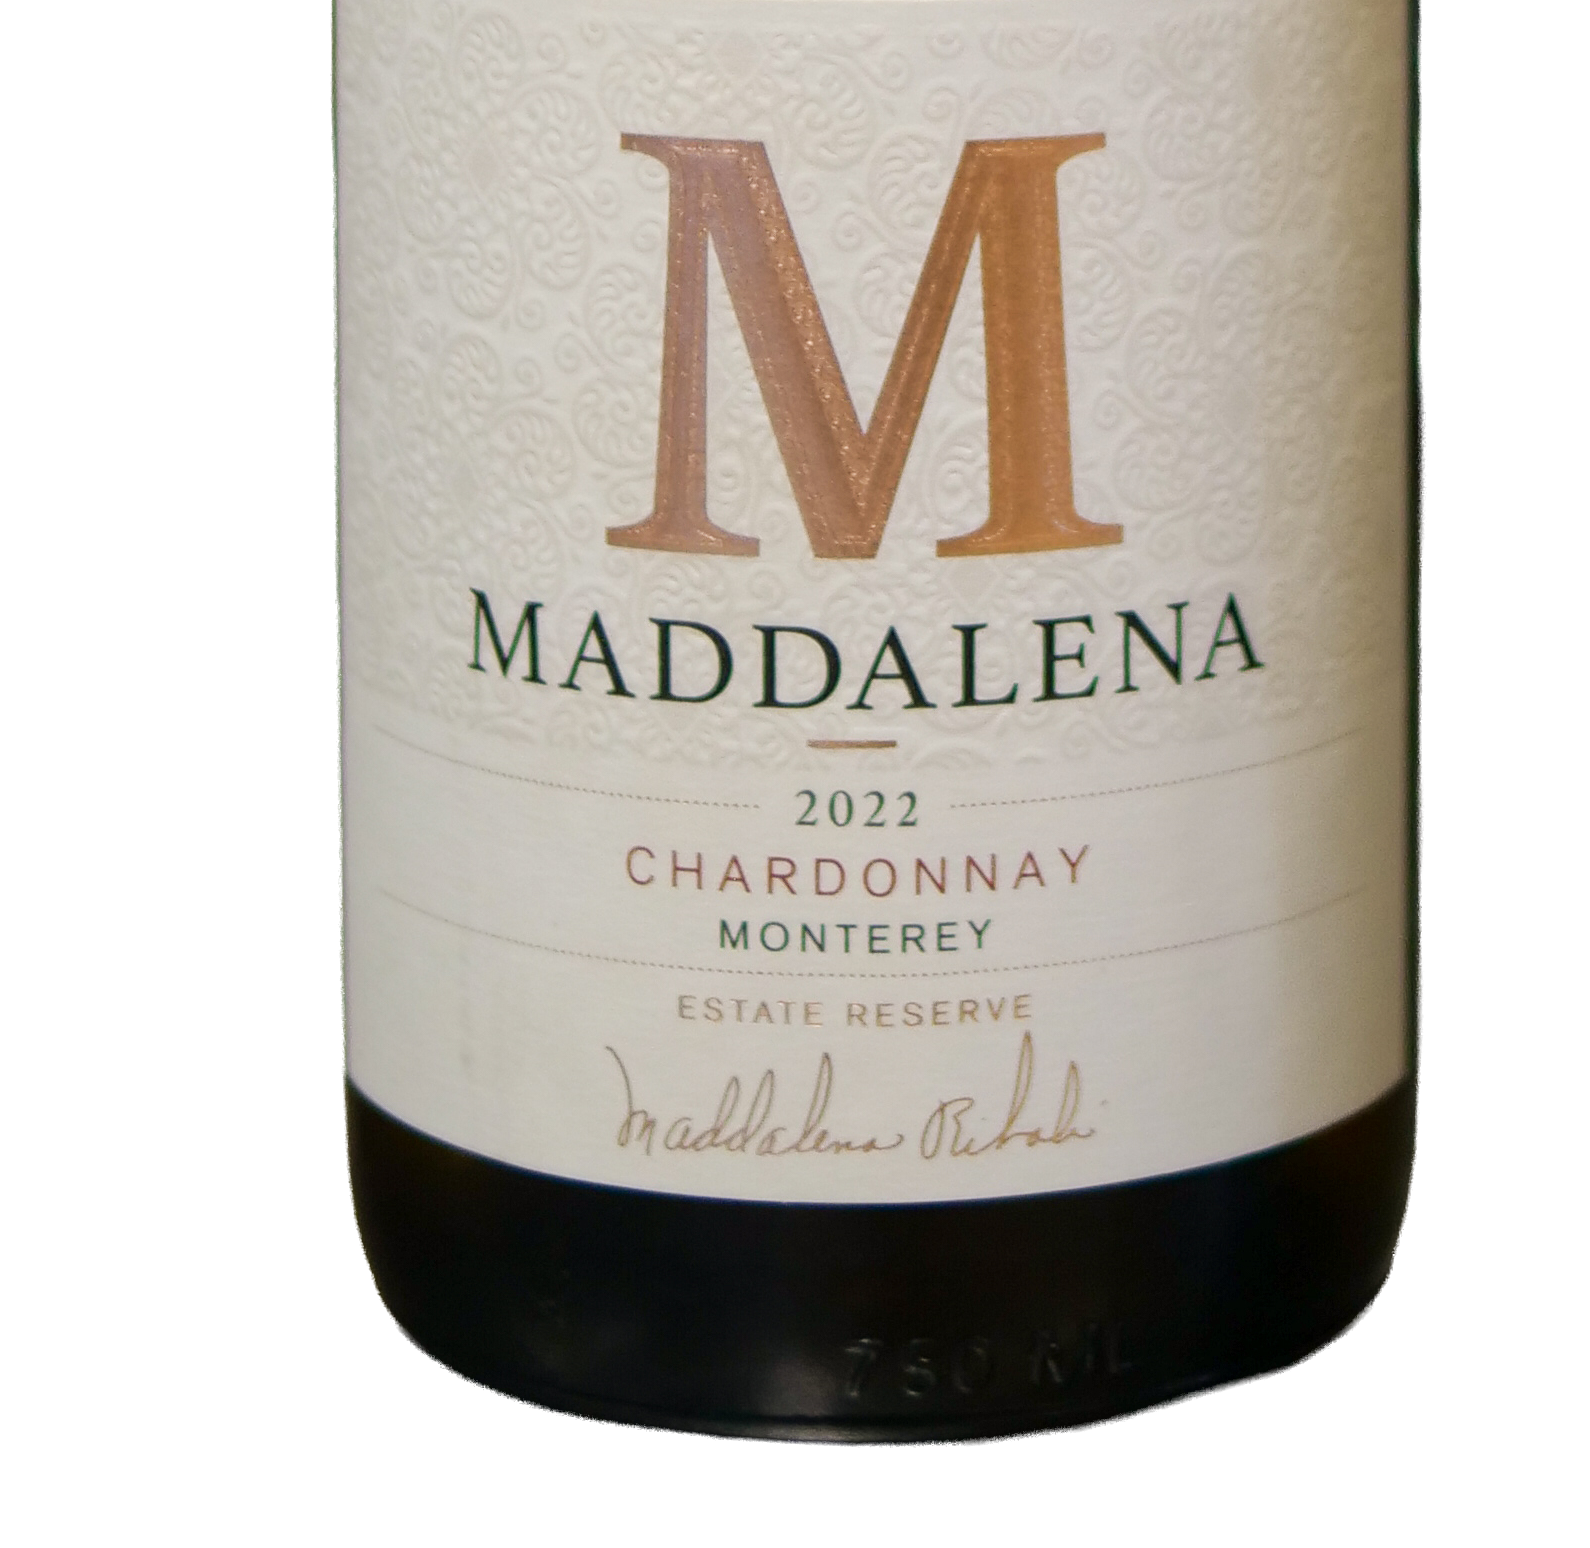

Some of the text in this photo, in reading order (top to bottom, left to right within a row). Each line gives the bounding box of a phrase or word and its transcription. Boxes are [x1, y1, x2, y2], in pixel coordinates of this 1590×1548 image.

[605, 130, 1125, 560] M
[466, 587, 1267, 712] MADDALENA
[795, 790, 918, 827] 2022
[625, 845, 1090, 897] CHARDONNAY
[719, 918, 992, 954] MONTEREY
[677, 994, 1033, 1028] ESTATE RESERVE
